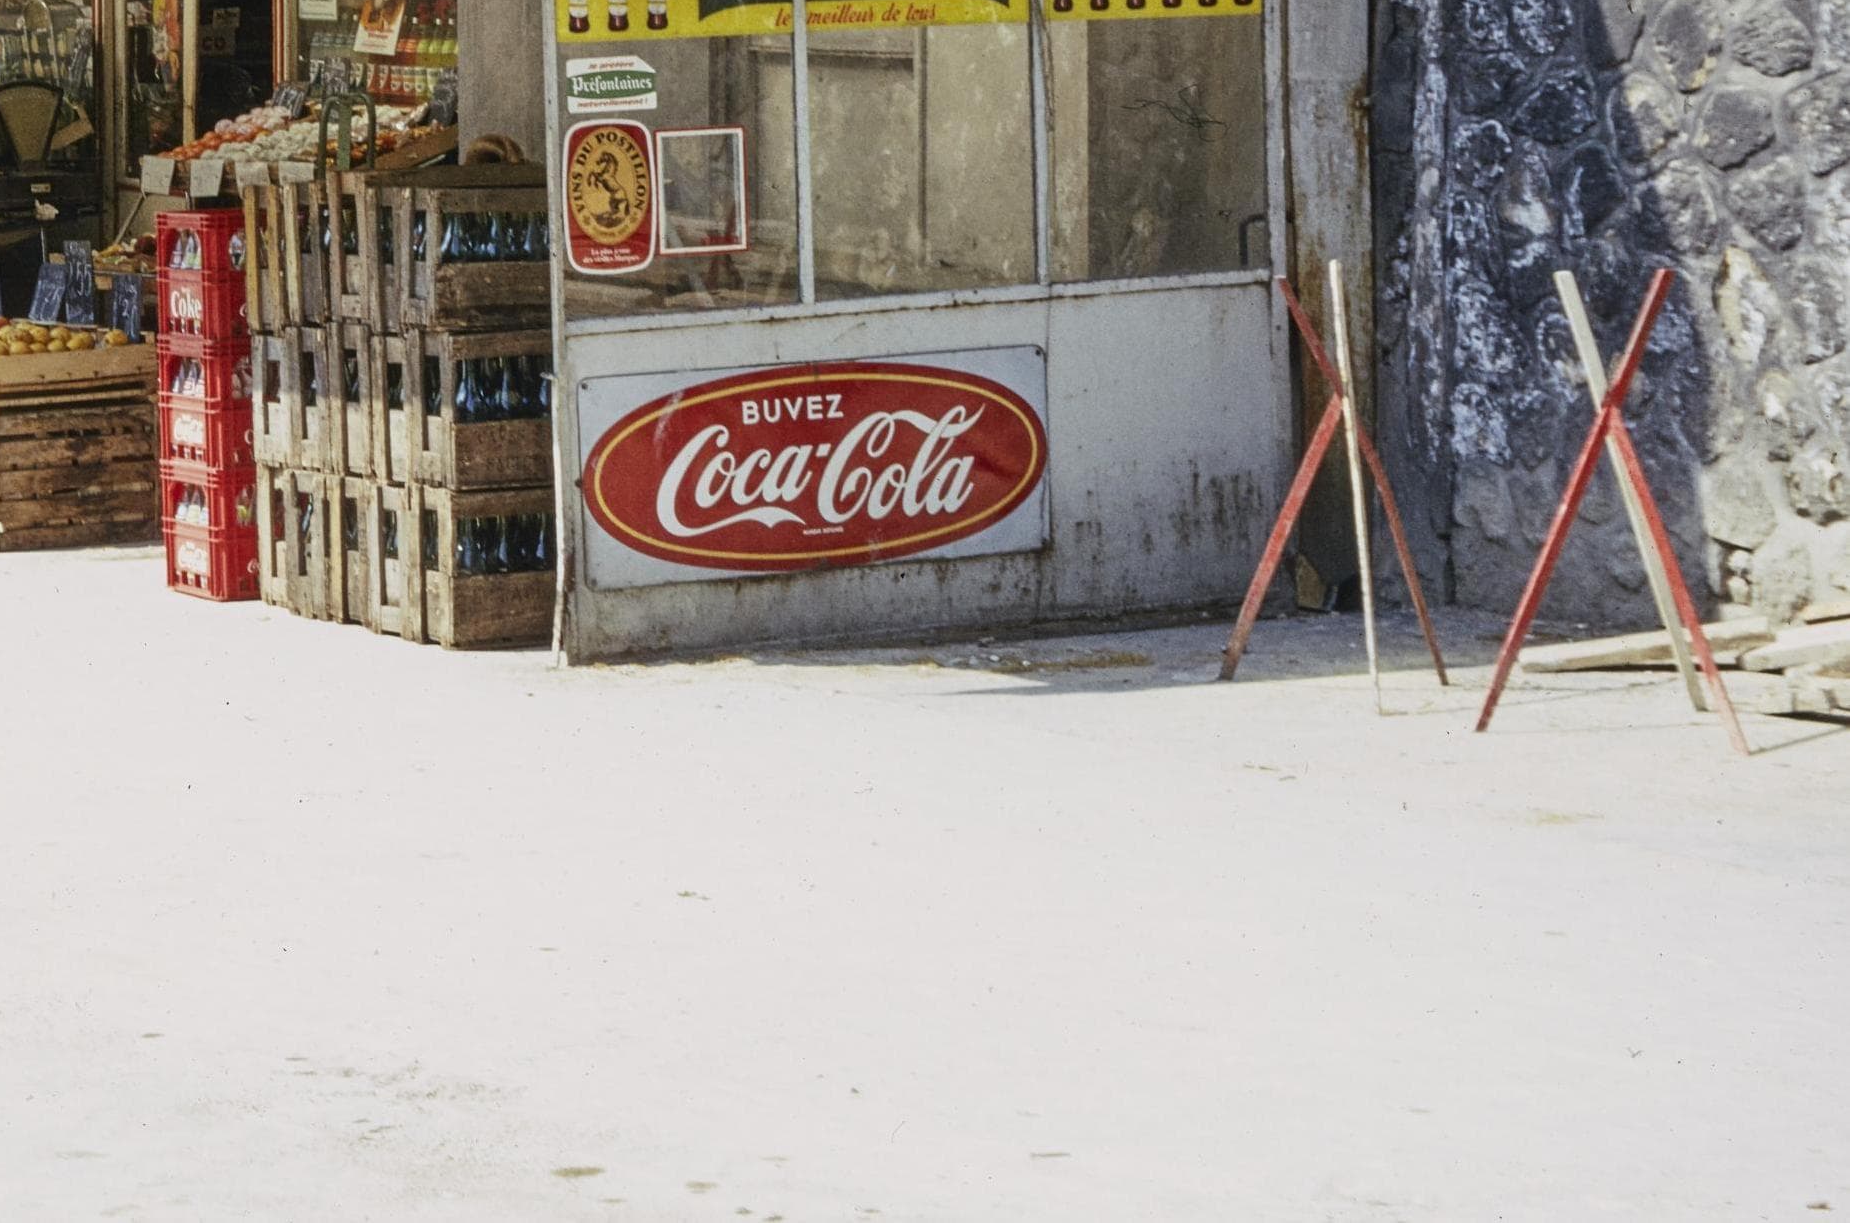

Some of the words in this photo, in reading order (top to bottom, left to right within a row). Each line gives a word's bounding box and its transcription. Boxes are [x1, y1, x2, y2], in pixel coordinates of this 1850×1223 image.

[805, 2, 874, 24] meilleur
[881, 1, 901, 21] de
[905, 0, 936, 21] tous
[576, 142, 593, 167] DU
[595, 131, 647, 211] POSTILLON
[572, 172, 585, 213] VINS
[741, 393, 844, 425] BUVEZ
[656, 403, 986, 538] Coca-Cola
